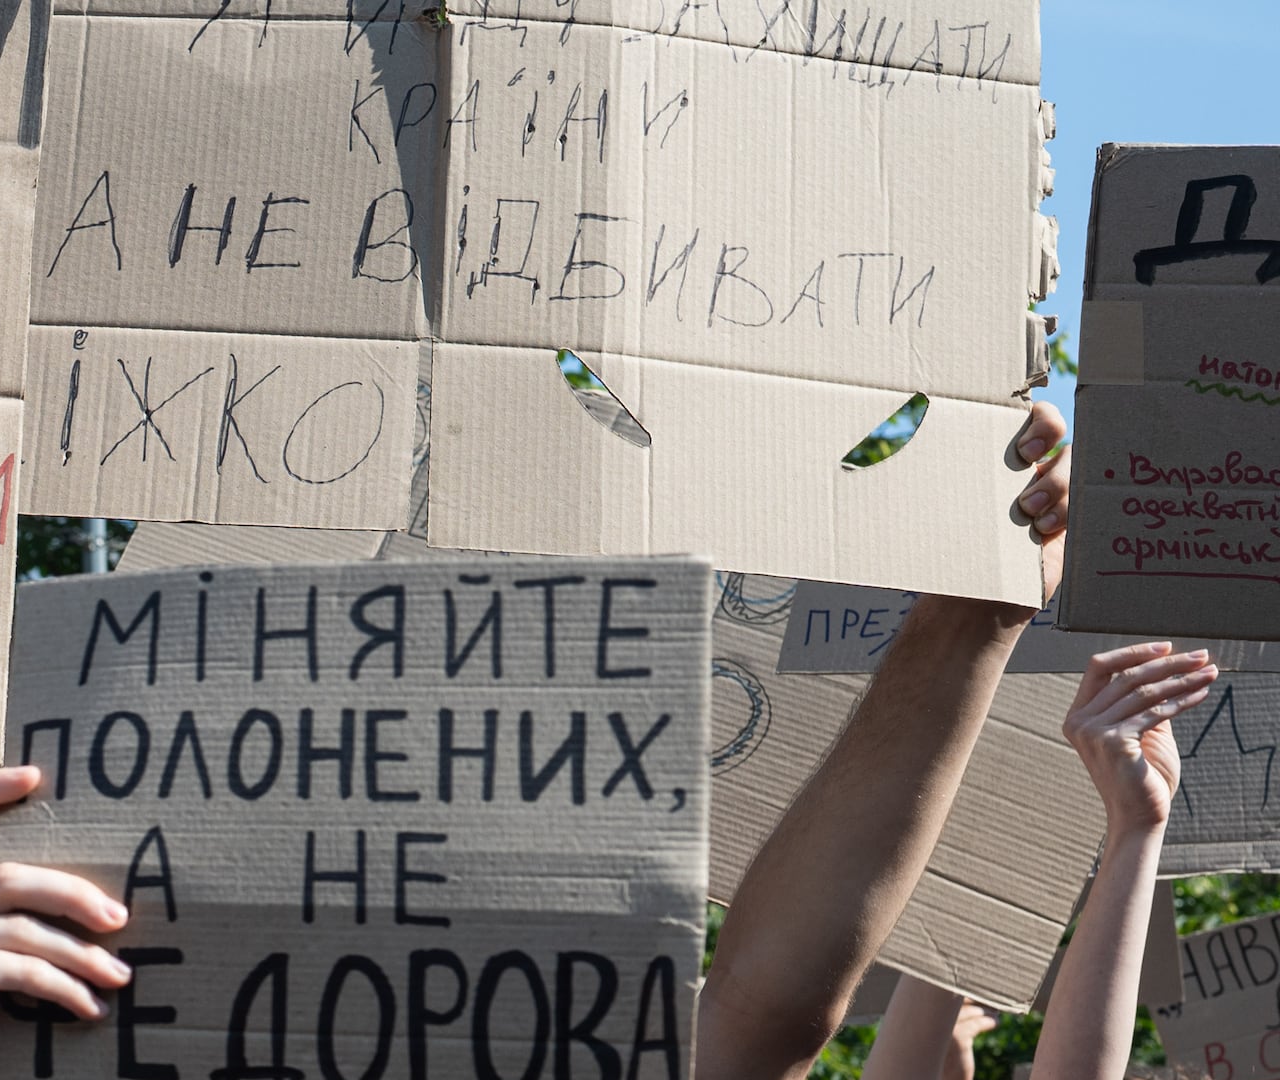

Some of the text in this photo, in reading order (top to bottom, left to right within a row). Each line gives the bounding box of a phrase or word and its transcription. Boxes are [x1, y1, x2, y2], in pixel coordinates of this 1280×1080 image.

[349, 67, 688, 164] КРАЇНИ
[47, 171, 122, 278] А
[167, 183, 310, 274] НЕ
[22, 707, 689, 815] ПОЛОНЕНИХ,
[124, 825, 453, 928] А НЕ
